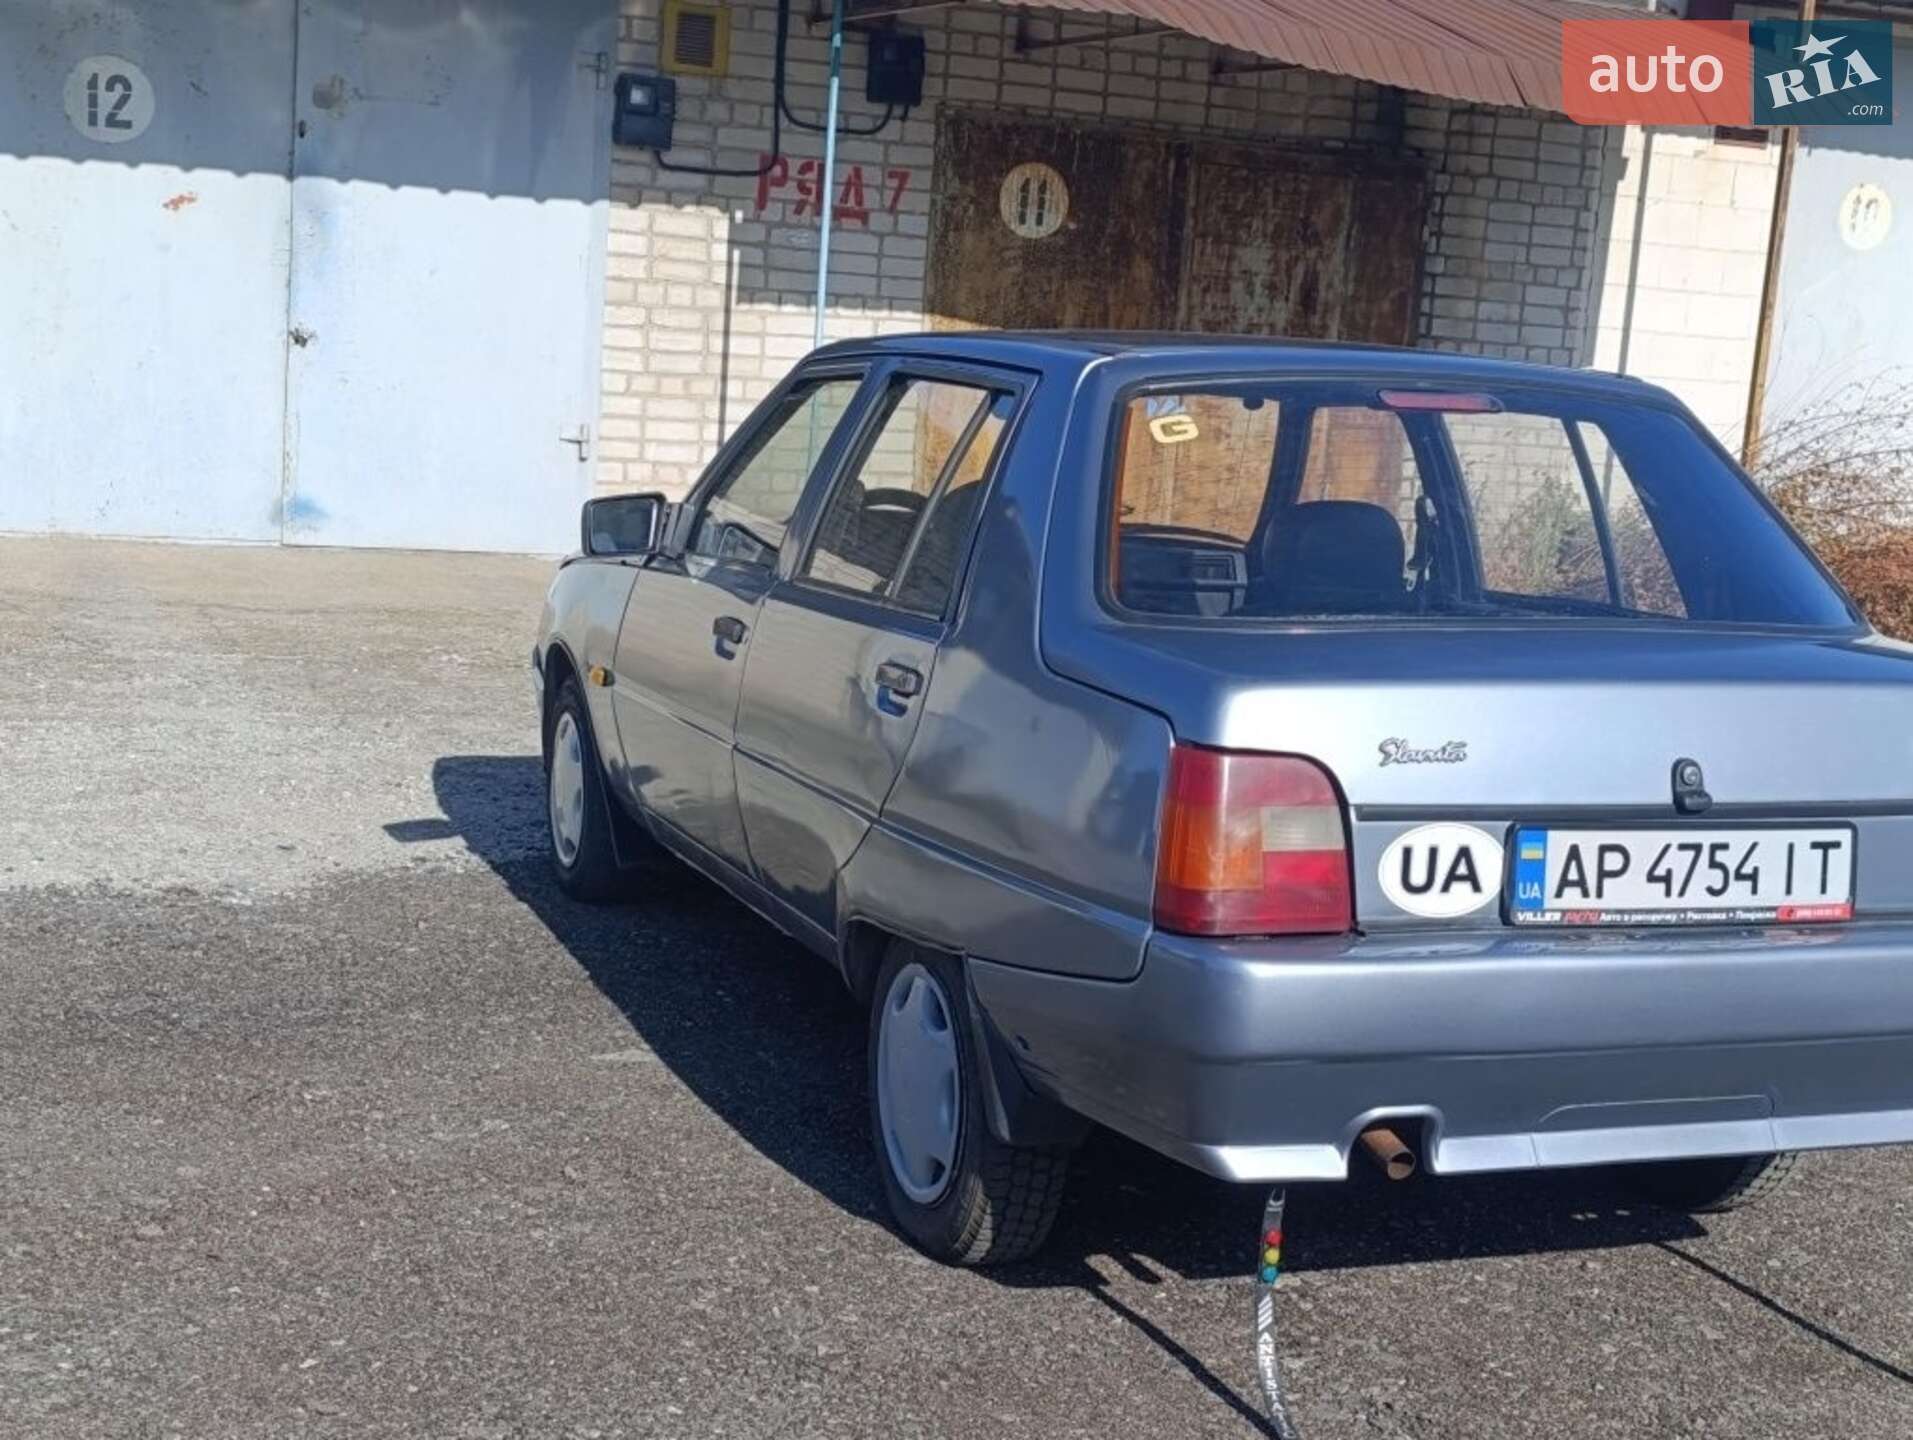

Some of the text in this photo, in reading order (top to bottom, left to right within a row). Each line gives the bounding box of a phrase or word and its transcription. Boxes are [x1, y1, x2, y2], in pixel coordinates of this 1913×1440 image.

[86, 72, 133, 130] 12
[756, 152, 913, 226] РЯД 7
[1018, 177, 1048, 227] 11
[1401, 845, 1483, 895] UA
[1518, 881, 1542, 899] UA
[1553, 840, 1843, 900] AP 4754 IT
